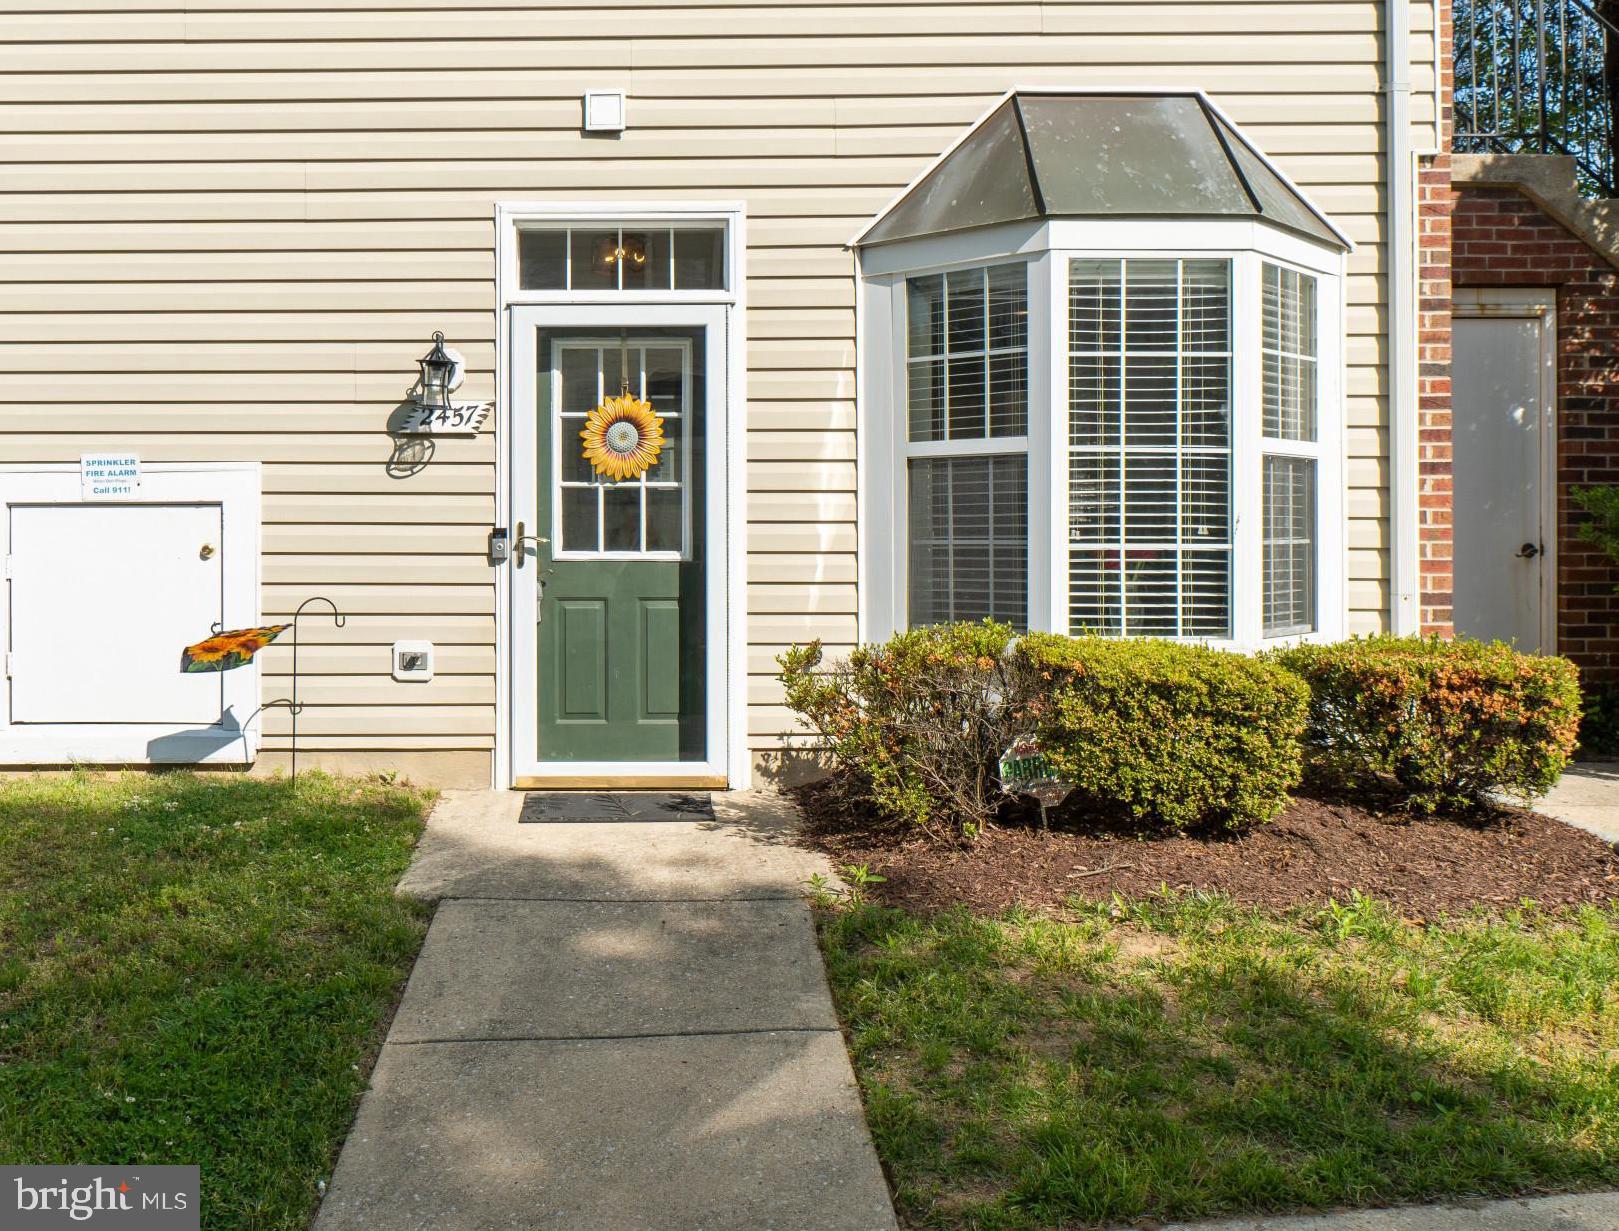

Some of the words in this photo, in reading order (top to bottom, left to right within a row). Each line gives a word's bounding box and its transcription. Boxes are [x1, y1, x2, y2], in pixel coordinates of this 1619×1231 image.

[420, 405, 479, 427] 2457
[86, 459, 136, 467] SPRINKLER
[107, 469, 137, 477] ALARM
